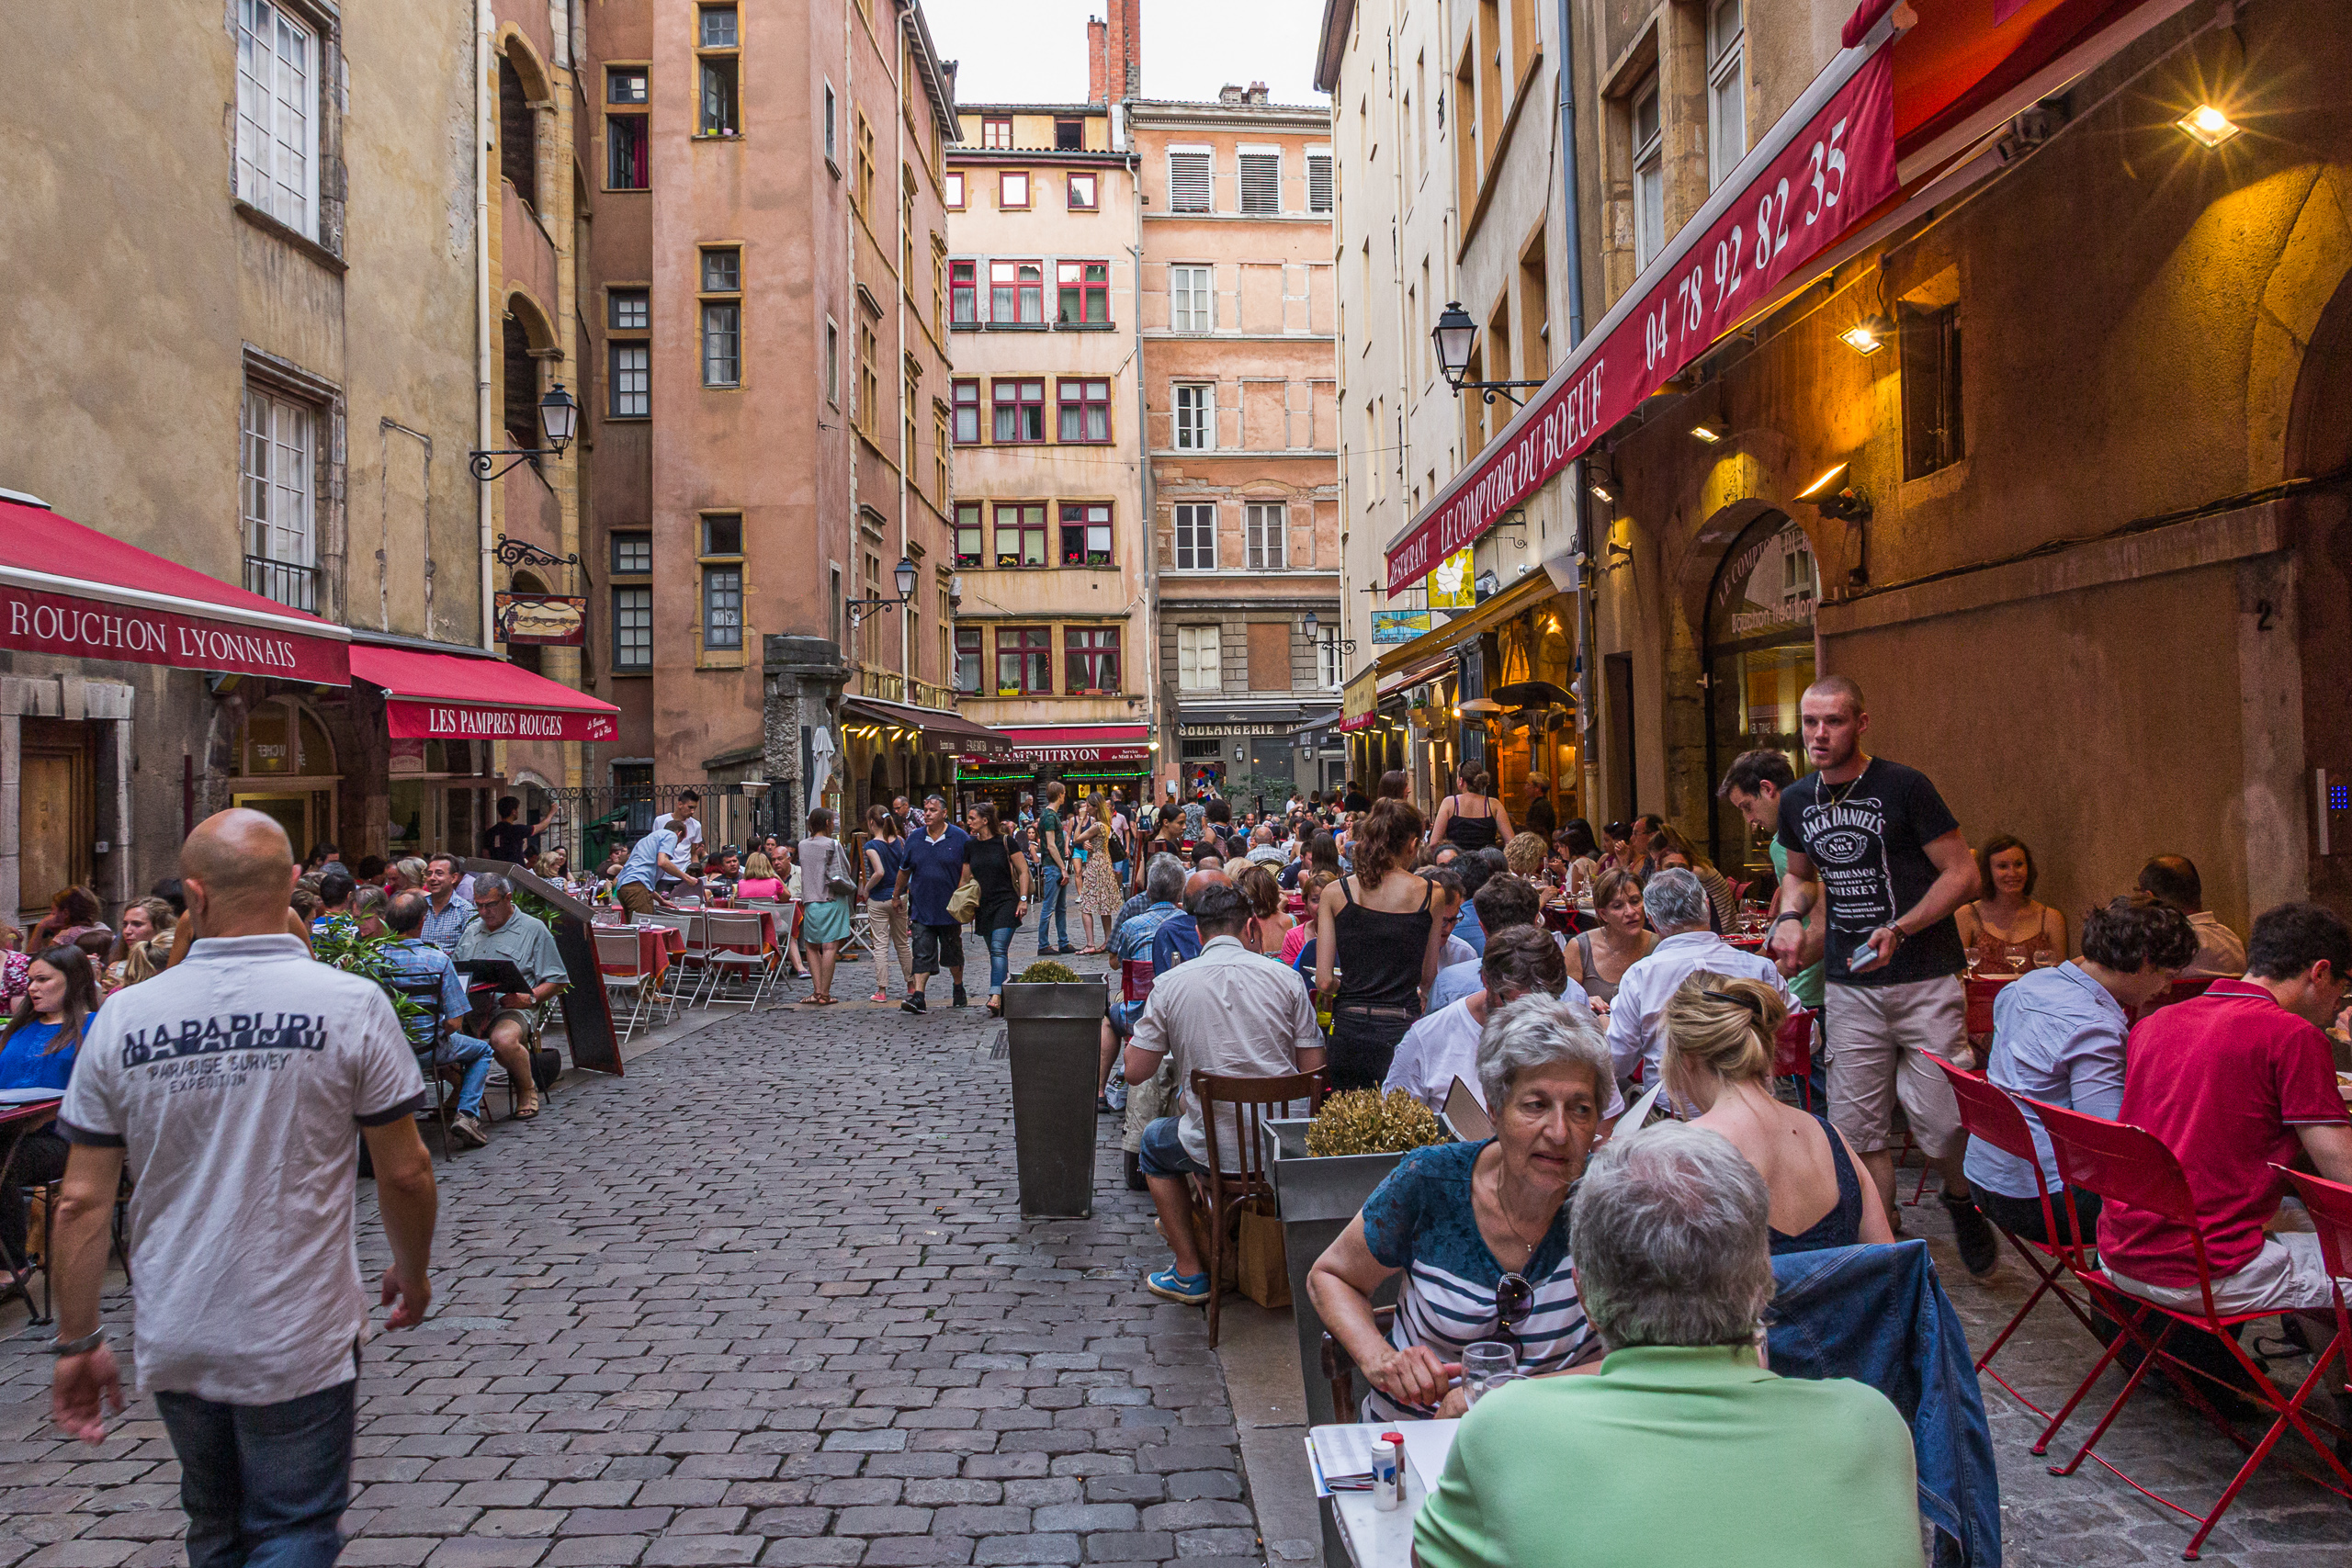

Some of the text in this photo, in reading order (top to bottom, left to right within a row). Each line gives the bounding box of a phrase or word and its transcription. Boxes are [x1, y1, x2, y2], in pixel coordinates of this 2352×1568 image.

[1645, 117, 1847, 371] 04 78 92 82 35
[1388, 358, 1604, 588] RESTAURANT LE COMPTOIR DU BOEUF
[1732, 608, 1770, 634] Bouchon
[2256, 598, 2273, 632] 2
[178, 626, 297, 668] LYONNAIS
[429, 708, 562, 736] LES PAMPRES ROUGES
[1178, 724, 1274, 737] BOULANGERIE
[1802, 806, 1886, 842] JACK DANIEL'S
[1820, 866, 1877, 880] Tennessee
[1828, 884, 1878, 897] WHISKEY
[147, 1051, 288, 1082] PARADISE SURVEY
[169, 1073, 247, 1094] EXPEDITION
